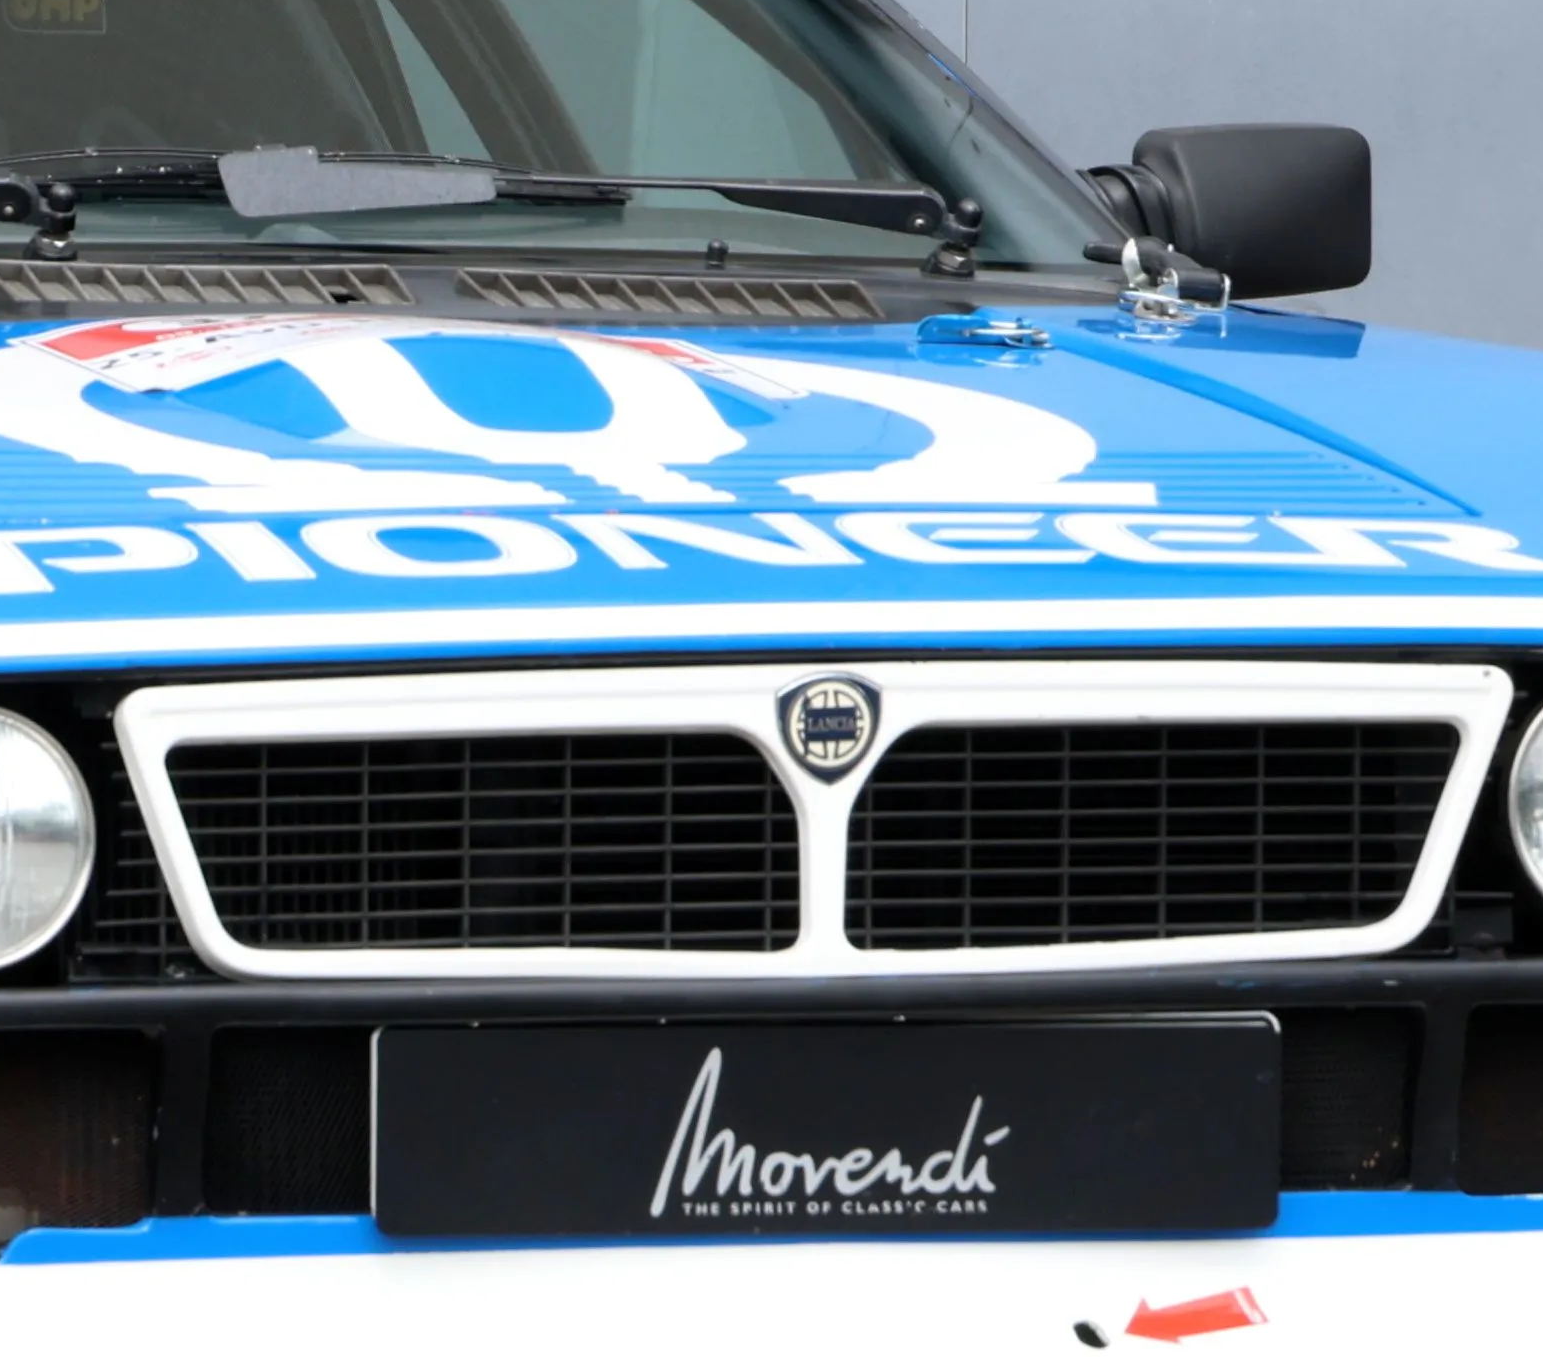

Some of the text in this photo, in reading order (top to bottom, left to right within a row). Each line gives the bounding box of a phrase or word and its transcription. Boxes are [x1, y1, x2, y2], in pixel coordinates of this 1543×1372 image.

[807, 715, 856, 733] LANCIA
[682, 1201, 720, 1217] THE
[730, 1200, 797, 1216] SPIRIT
[806, 1200, 832, 1215] OF
[936, 1199, 988, 1214] CARS
